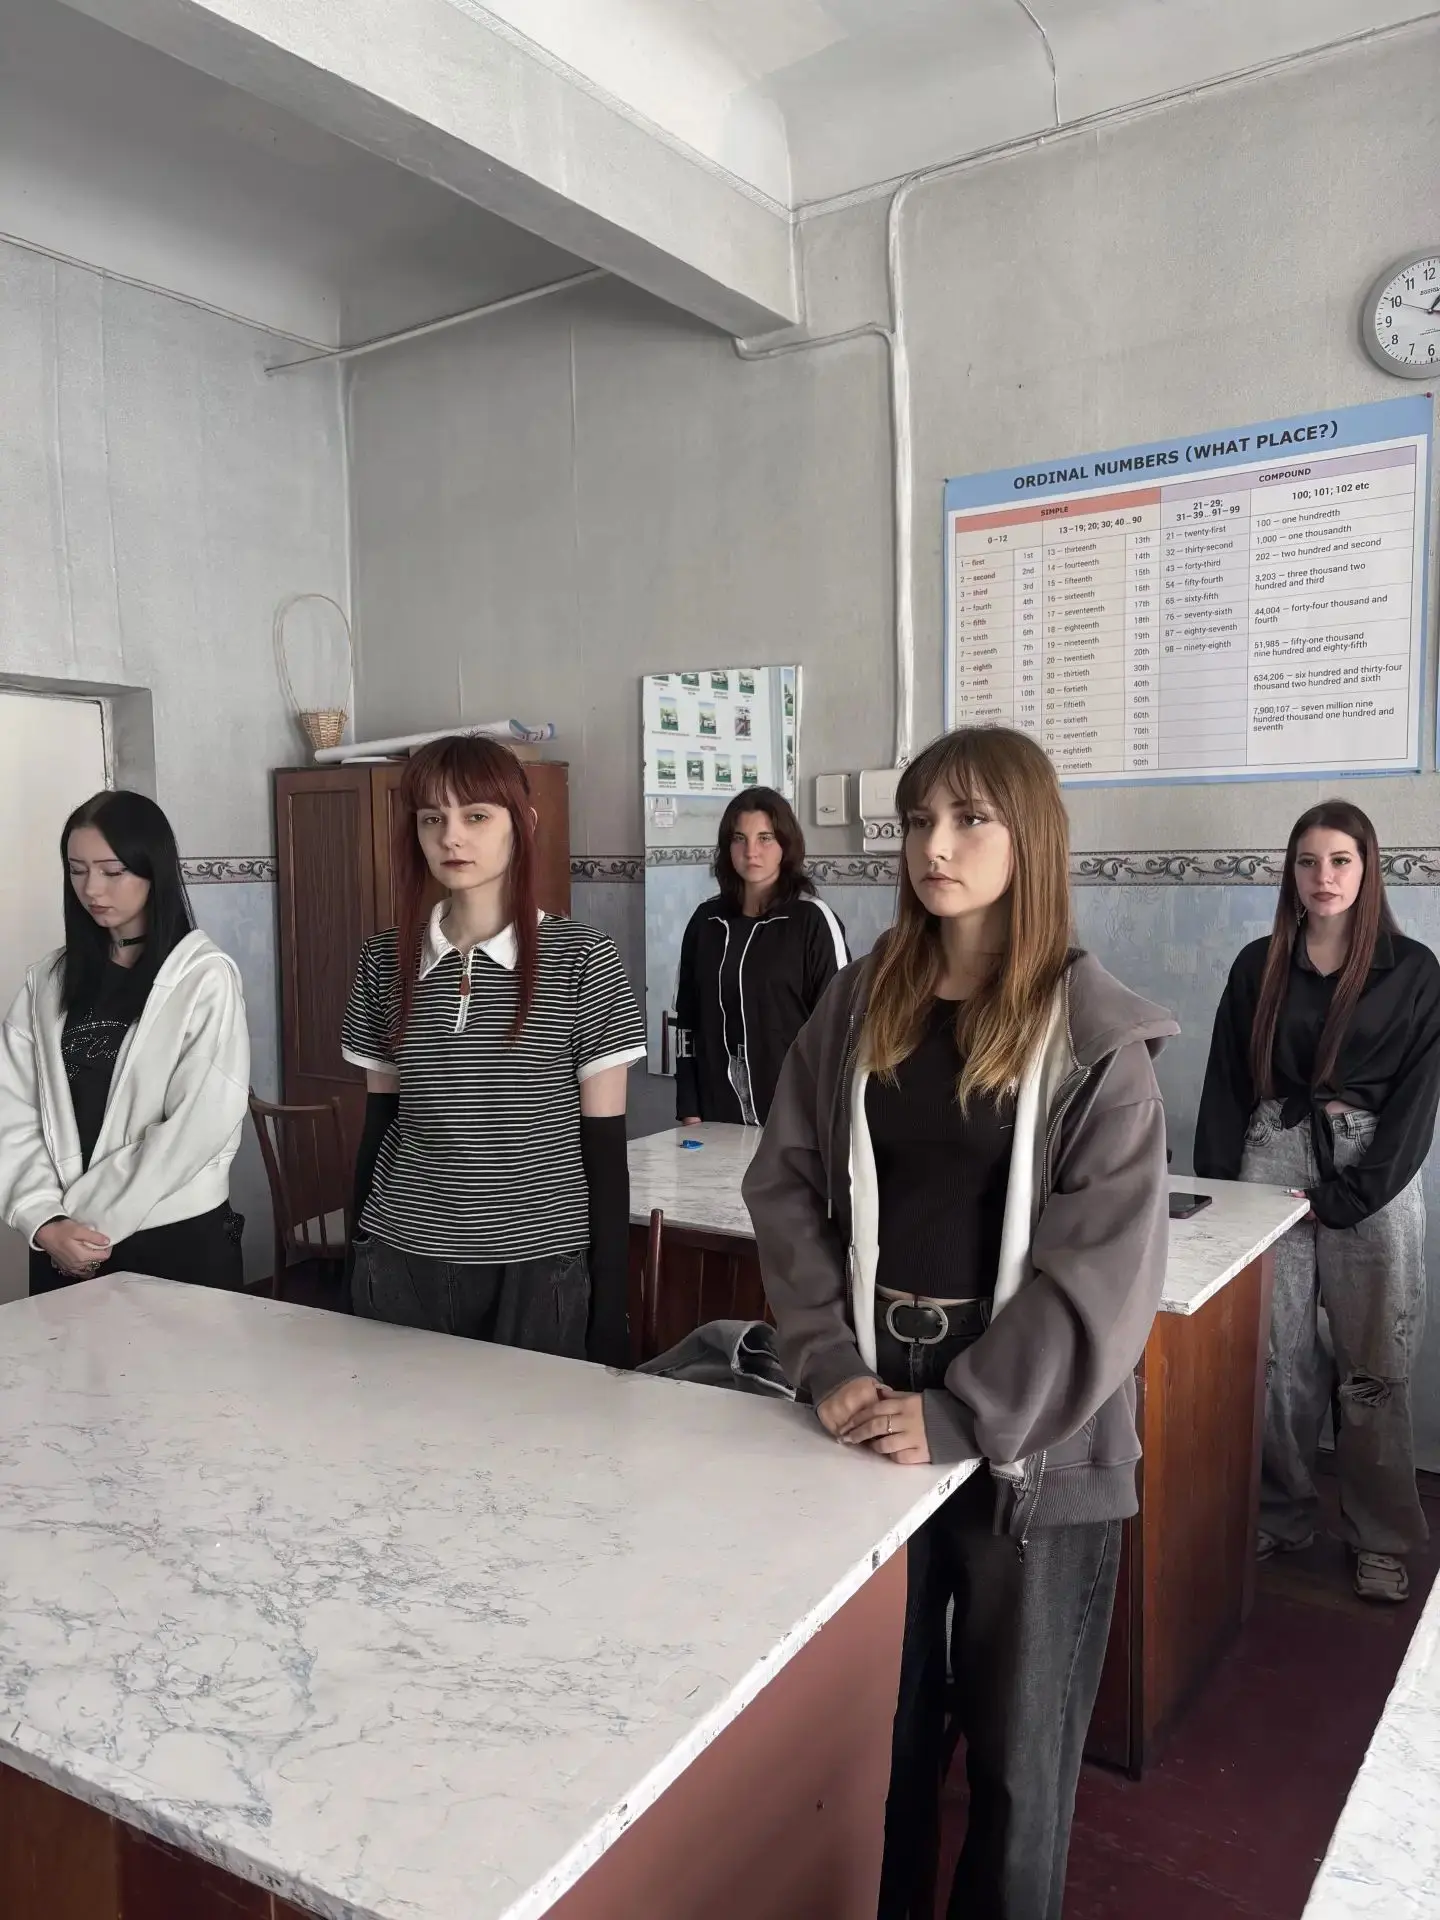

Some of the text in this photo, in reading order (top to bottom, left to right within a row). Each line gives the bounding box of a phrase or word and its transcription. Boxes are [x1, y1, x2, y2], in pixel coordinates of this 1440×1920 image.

[1424, 268, 1435, 280] 12
[1405, 278, 1414, 290] 11
[1390, 296, 1402, 308] 10
[1385, 316, 1392, 327] 9
[1392, 335, 1398, 344] 8
[1409, 343, 1415, 355] 7
[1428, 344, 1434, 356] 6
[1014, 420, 1338, 489] ORDINAL NUMBERS (WHAT PLACE?)
[1259, 468, 1311, 482] COMPOUND
[1292, 491, 1311, 500] 100;
[1314, 487, 1333, 496] 101;
[1336, 484, 1352, 493] 102
[1041, 506, 1068, 516] SIMPLE
[1257, 519, 1270, 527] 100
[1299, 509, 1340, 521] hundredth
[1166, 526, 1226, 540] 21 twenty-first
[1257, 536, 1277, 544] 1,000
[1306, 525, 1351, 537] thousandth
[1135, 536, 1150, 544] 13th
[1185, 541, 1233, 553] thirty-second
[1256, 538, 1381, 561] 202 two hundred and second
[1064, 559, 1099, 569] fourteenth
[1185, 559, 1221, 570] forty-third
[973, 572, 995, 581] second
[1255, 573, 1276, 582] 3,203
[1288, 570, 1307, 578] three
[1310, 564, 1348, 575] thousand
[1185, 575, 1223, 586] fifty-fourth
[1255, 576, 1324, 590] hundred and third
[1065, 590, 1095, 600] sixteenth
[1185, 593, 1219, 603] sixty-fifth
[1064, 605, 1105, 616] seventeenth
[1255, 595, 1387, 616] 44,004 forty-four thousand and
[1185, 608, 1232, 619] seventy-sixth
[1255, 615, 1277, 625] fourth
[1064, 622, 1099, 632] eighteenth
[1184, 623, 1237, 635] eighty-seventh
[1184, 640, 1231, 651] ninety-eighth
[1255, 632, 1364, 649] 51,985 fifty-one thousand
[1273, 646, 1304, 656] hundred
[1306, 645, 1321, 653] and
[1323, 641, 1367, 652] eighty-fifth
[1064, 654, 1095, 663] twentieth
[1254, 673, 1284, 682] 634,206
[1308, 668, 1341, 677] hundred
[1361, 663, 1402, 673] thirty-four
[1254, 681, 1289, 690] thousand
[1308, 676, 1340, 686] hundred
[1343, 676, 1358, 684] and
[1361, 674, 1380, 683] sixth
[1254, 705, 1290, 714] 7,900,107
[1326, 701, 1353, 710] million
[1253, 714, 1284, 723] hundred
[1287, 711, 1323, 721] thousand
[1343, 708, 1376, 717] hundred
[1379, 707, 1394, 715] and
[1254, 723, 1283, 731] seventh
